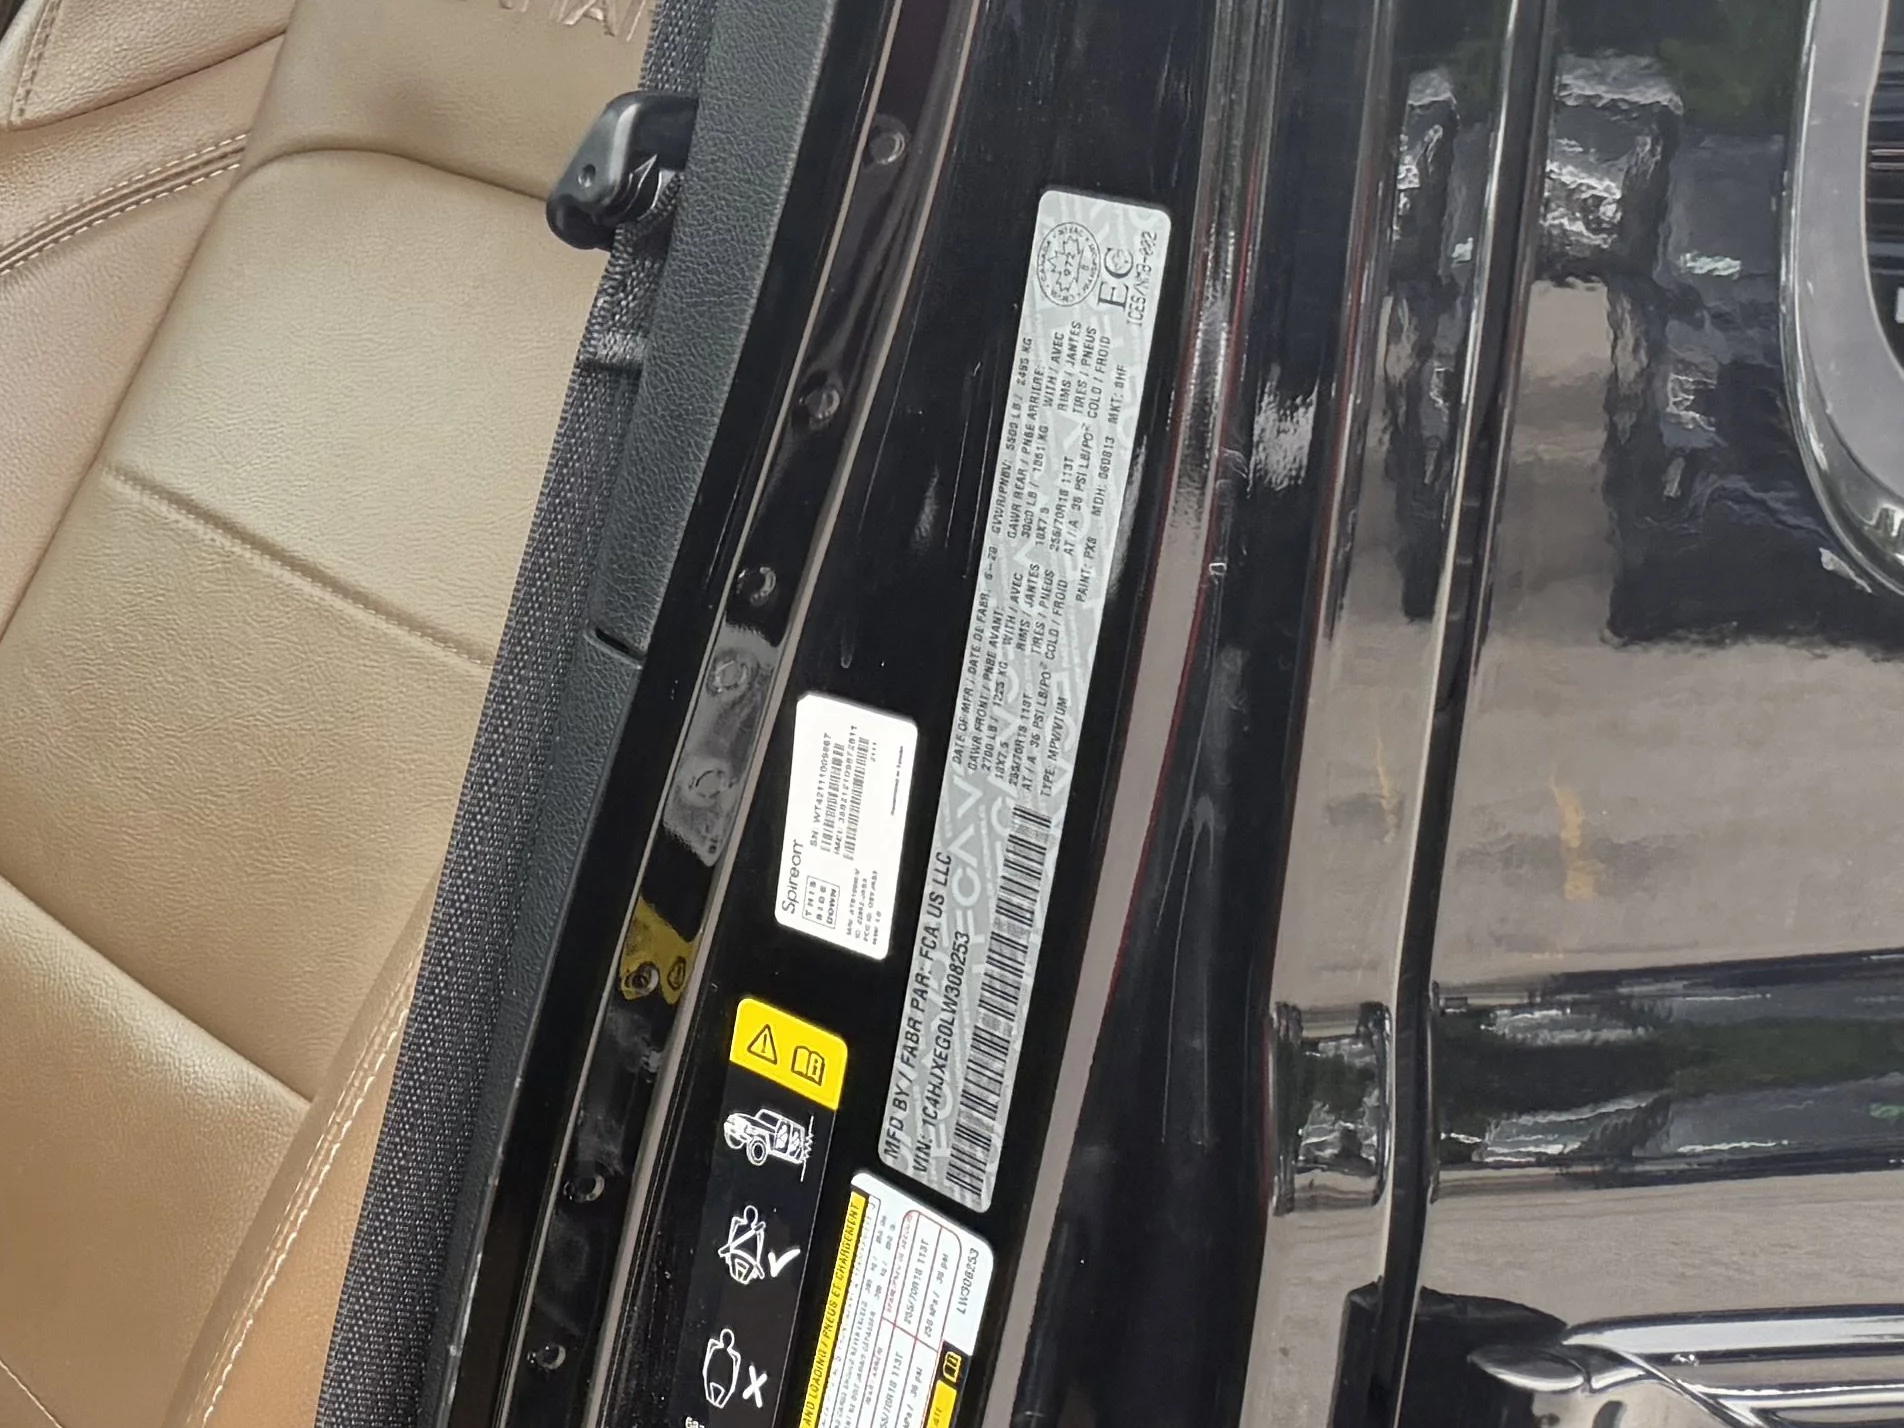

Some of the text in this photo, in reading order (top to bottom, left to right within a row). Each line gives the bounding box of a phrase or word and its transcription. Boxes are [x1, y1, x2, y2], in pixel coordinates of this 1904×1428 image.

[1021, 336, 1033, 353] KG
[1042, 375, 1057, 407] WITH
[1050, 331, 1065, 364] AVEC
[1057, 379, 1072, 411] RIMS
[1065, 320, 1082, 366] JANTES
[1073, 379, 1088, 414] TIRES
[1081, 326, 1097, 366] PNEUS
[1087, 385, 1102, 418] COLD
[1095, 335, 1111, 373] FROID
[1013, 467, 1028, 500] REAR
[1025, 489, 1037, 506] LB
[1036, 424, 1049, 442] KG
[1063, 540, 1075, 556] AT
[1075, 471, 1087, 491] PSI
[1002, 614, 1016, 646] WITH
[1009, 571, 1024, 603] AVEC
[1015, 619, 1030, 651] RIMS
[1023, 563, 1040, 608] JANTES
[1030, 620, 1046, 655] TIRES
[1039, 568, 1055, 609] PNEUS
[1044, 627, 1059, 661] COLD
[1052, 578, 1068, 616] FROID
[1075, 562, 1092, 602] PAINT:
[967, 644, 981, 675] DATE
[957, 715, 969, 732] OF
[960, 686, 974, 714] MFR
[986, 723, 997, 740] LB
[951, 734, 965, 764] DATE
[980, 741, 994, 771] 2700
[1021, 776, 1033, 791] AT
[1032, 708, 1045, 729] PSI
[781, 836, 805, 915] Spireon
[883, 850, 952, 1161] MFD BY / FABR PAR: FCA US LLC
[913, 1132, 934, 1175] VIN:
[802, 1399, 816, 1427] AND
[831, 1282, 841, 1298] ET
